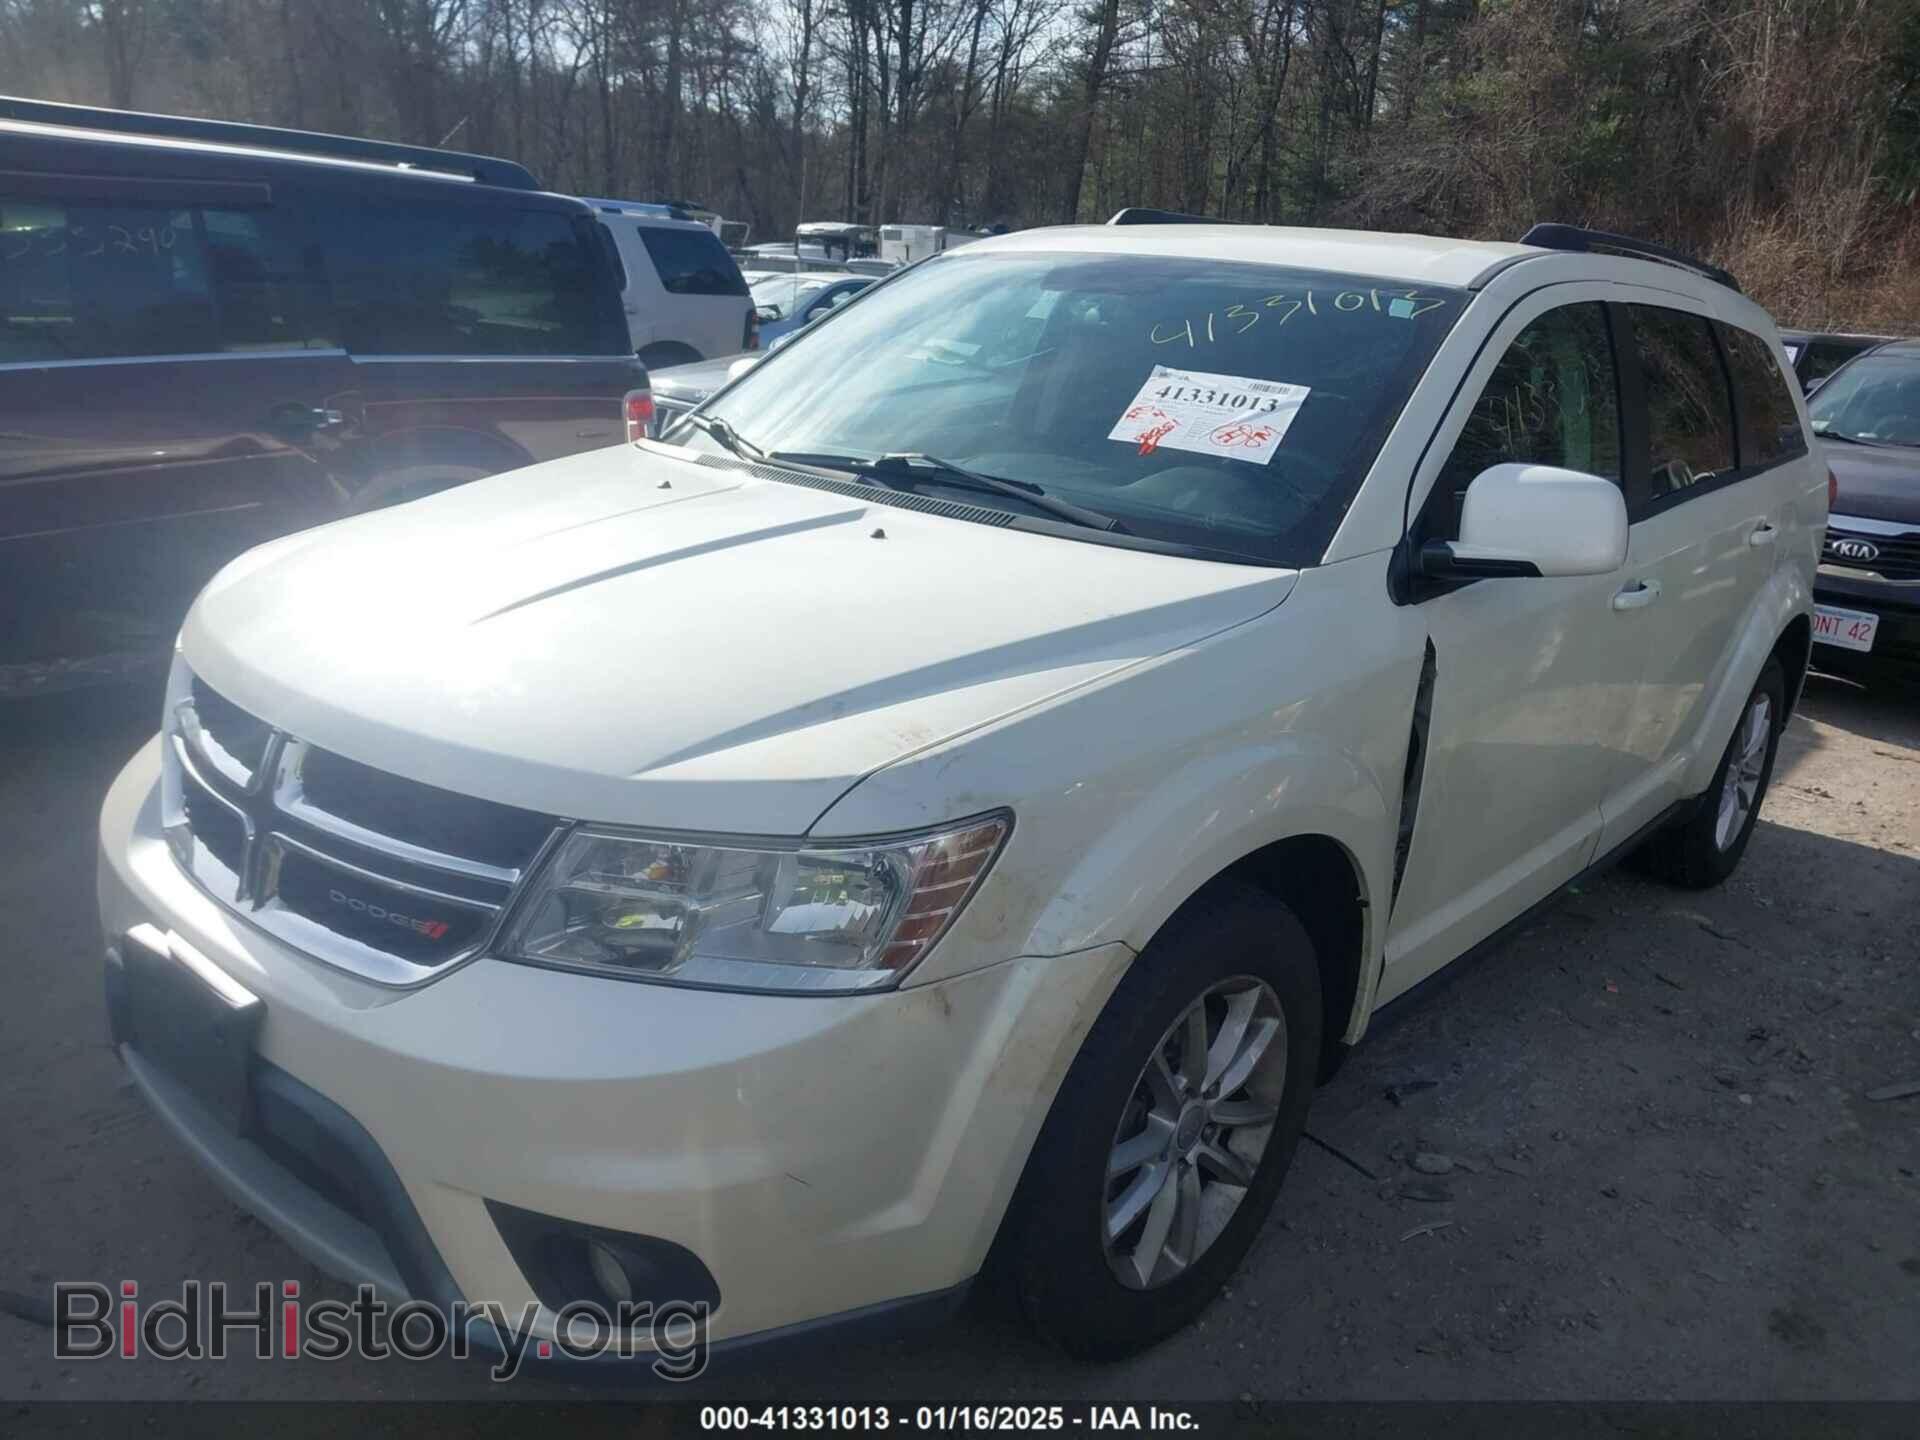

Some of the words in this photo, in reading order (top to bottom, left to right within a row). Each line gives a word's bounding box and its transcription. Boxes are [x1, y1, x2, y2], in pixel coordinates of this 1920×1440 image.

[1150, 289, 1446, 348] 41331013
[1154, 384, 1280, 413] 41331013
[1838, 541, 1871, 559] KIA
[1848, 622, 1872, 641] 42
[329, 888, 430, 935] DODGE
